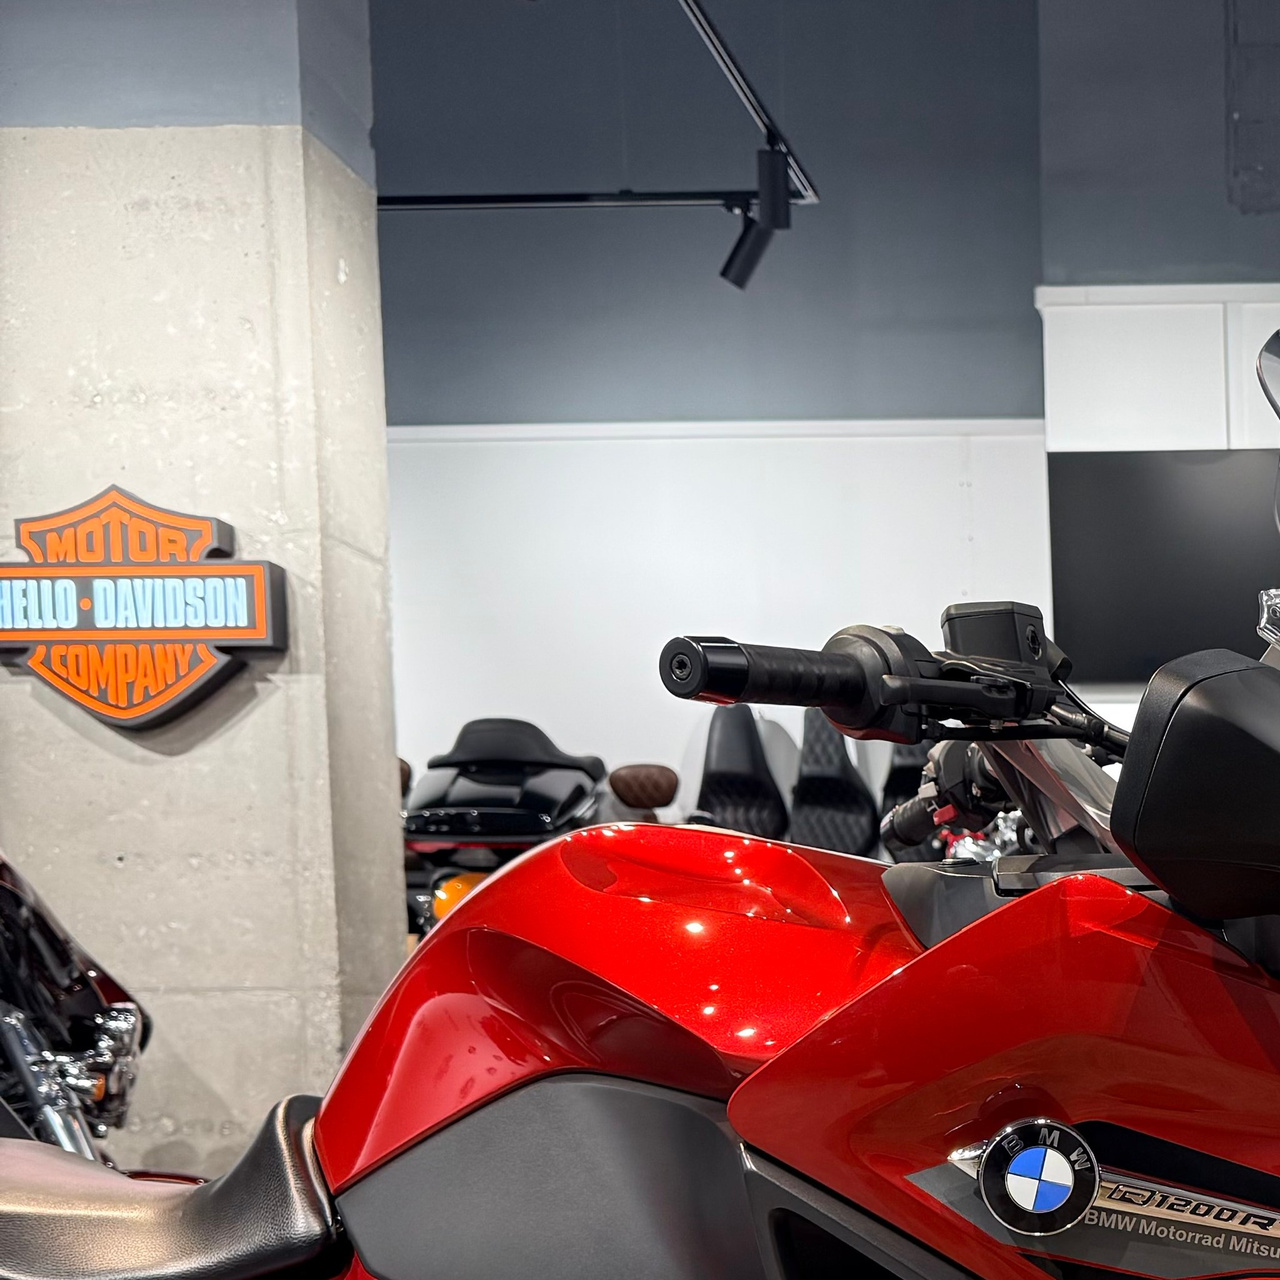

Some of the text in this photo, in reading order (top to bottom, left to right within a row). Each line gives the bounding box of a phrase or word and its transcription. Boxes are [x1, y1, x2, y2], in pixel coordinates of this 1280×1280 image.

[46, 506, 187, 563] MOTOR
[93, 577, 248, 628] DAVIDSON
[51, 643, 194, 707] COMPANY
[1002, 1127, 1091, 1170] BMW
[1084, 1209, 1136, 1231] BMW
[1138, 1218, 1225, 1249] Motorrad
